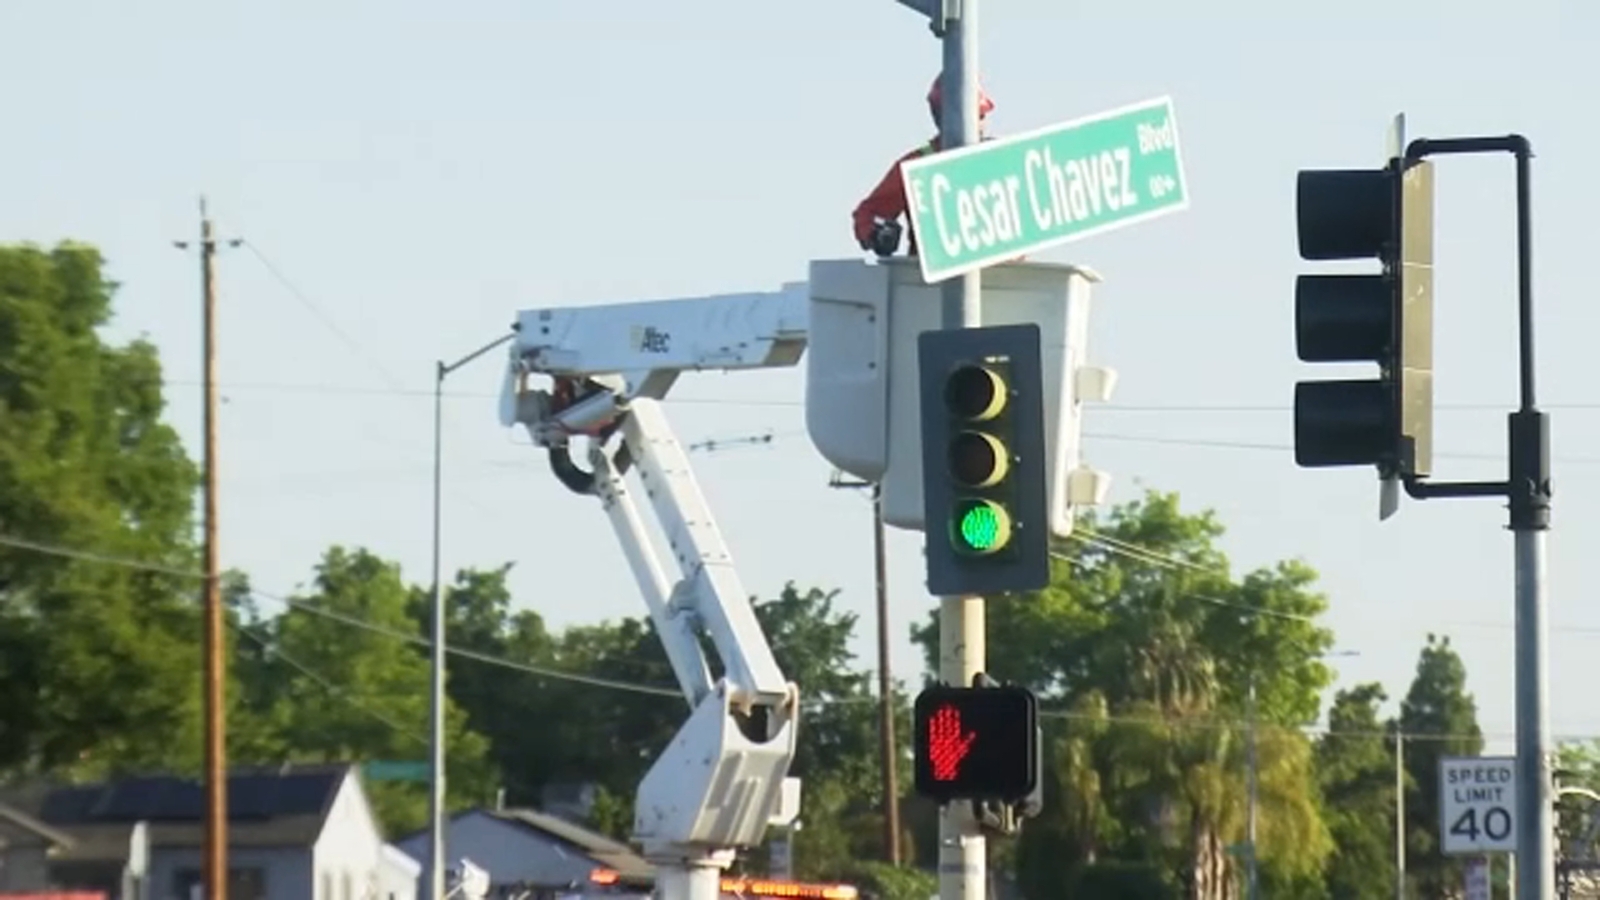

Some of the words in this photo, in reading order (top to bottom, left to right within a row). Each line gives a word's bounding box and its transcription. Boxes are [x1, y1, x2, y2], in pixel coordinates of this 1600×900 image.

[1136, 117, 1173, 154] Blvd
[912, 178, 930, 214] E
[930, 173, 1023, 257] Cesar
[1025, 146, 1138, 231] Chavez
[1448, 768, 1511, 784] SPEED
[1454, 788, 1504, 803] LIMIT
[1451, 807, 1512, 841] 40
